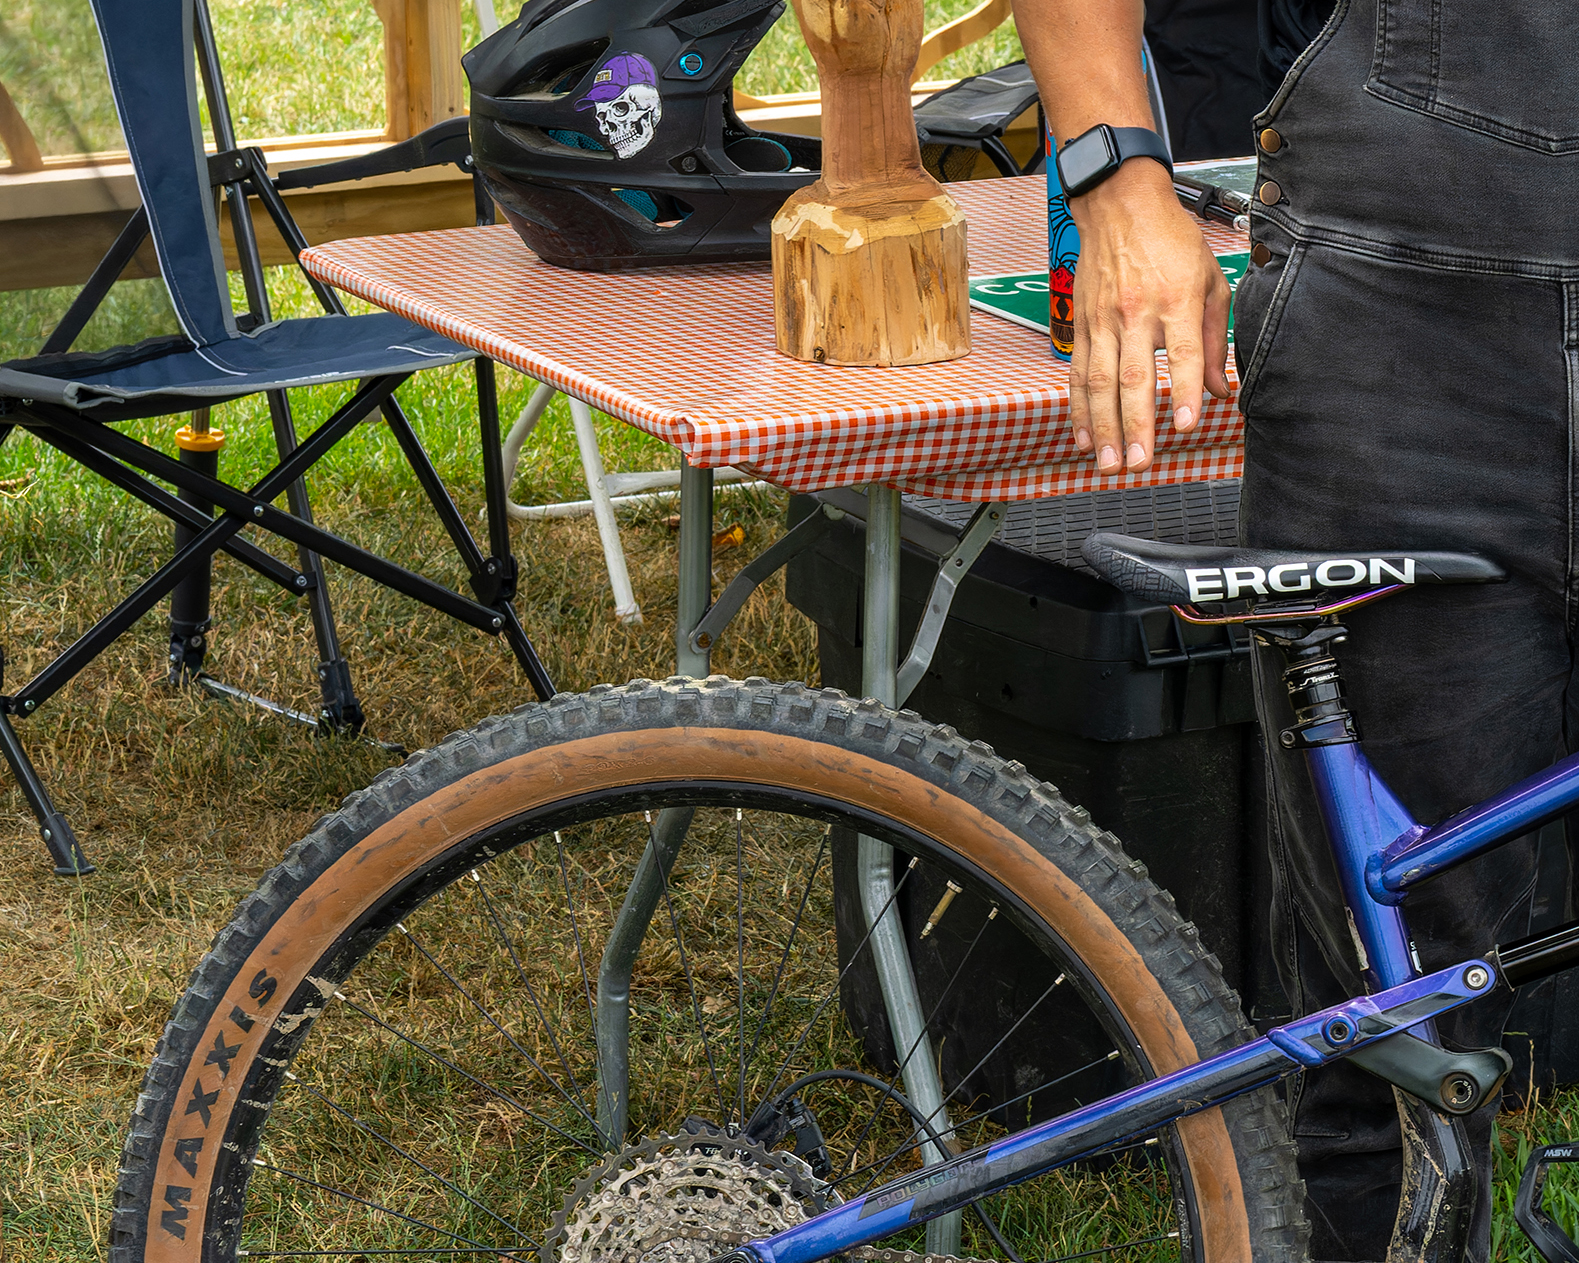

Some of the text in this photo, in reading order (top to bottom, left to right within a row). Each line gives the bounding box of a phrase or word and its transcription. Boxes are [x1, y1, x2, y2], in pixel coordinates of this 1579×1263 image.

[1184, 558, 1416, 603] ERGON
[160, 967, 278, 1241] MAXXIS
[1544, 1149, 1573, 1157] MSW
